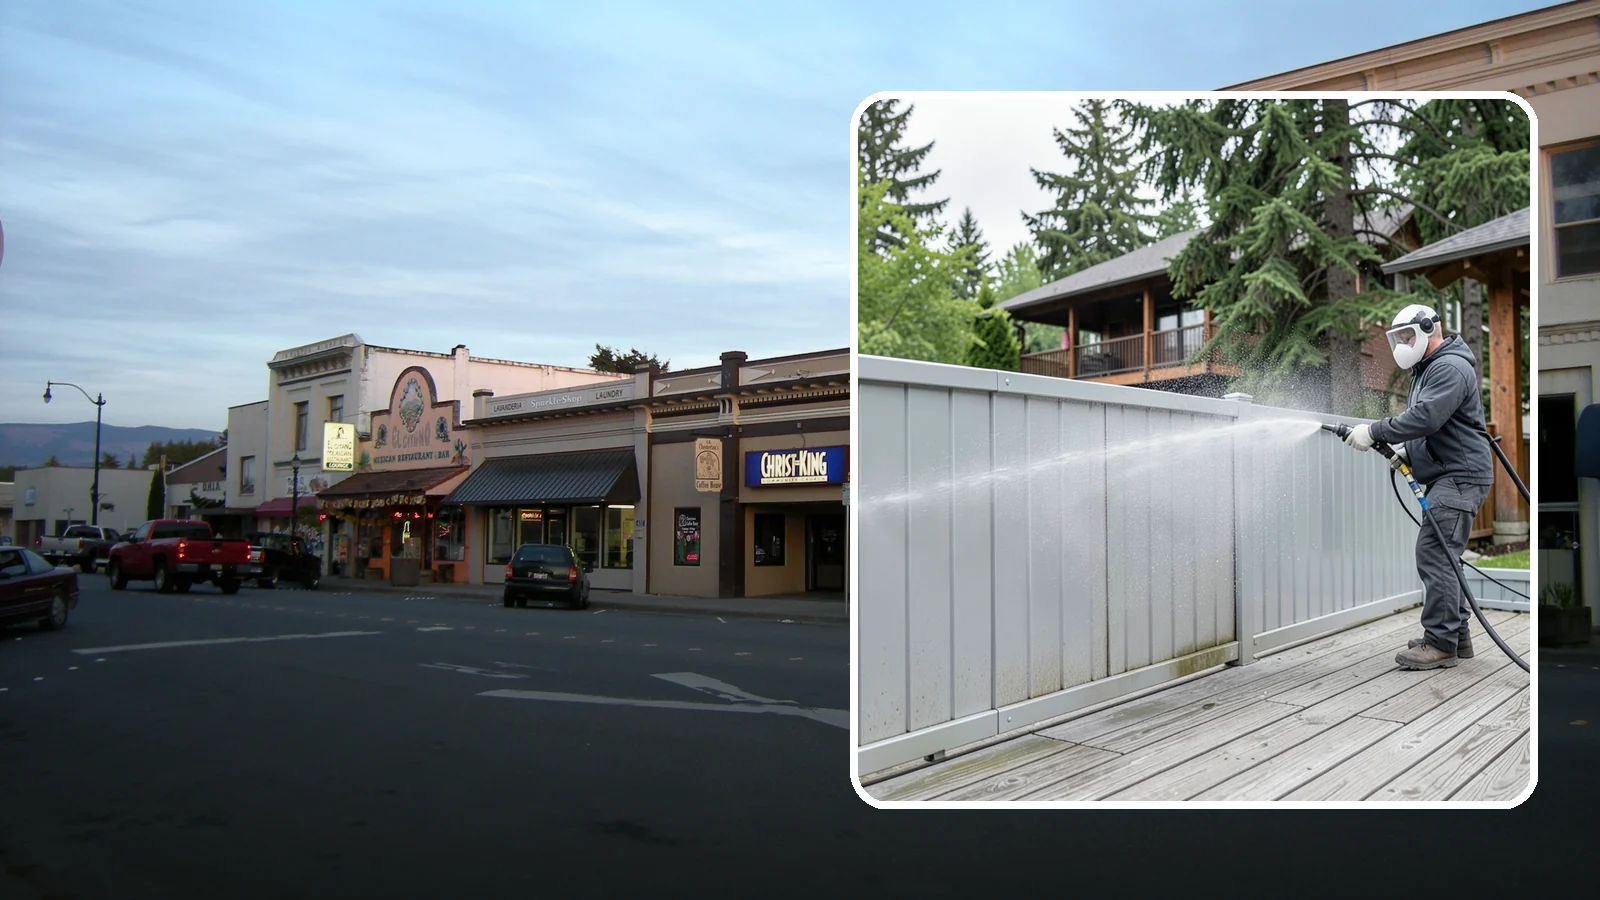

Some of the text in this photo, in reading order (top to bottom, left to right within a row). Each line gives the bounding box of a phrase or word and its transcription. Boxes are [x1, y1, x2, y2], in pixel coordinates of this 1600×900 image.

[493, 402, 523, 412] LAVANDERIA
[562, 394, 583, 404] Shop
[595, 389, 623, 400] LAUNDRY
[373, 455, 396, 464] MEXICAN
[397, 452, 433, 462] RESTAURANT
[438, 450, 450, 459] BAR
[760, 450, 827, 478] CHRIST KING
